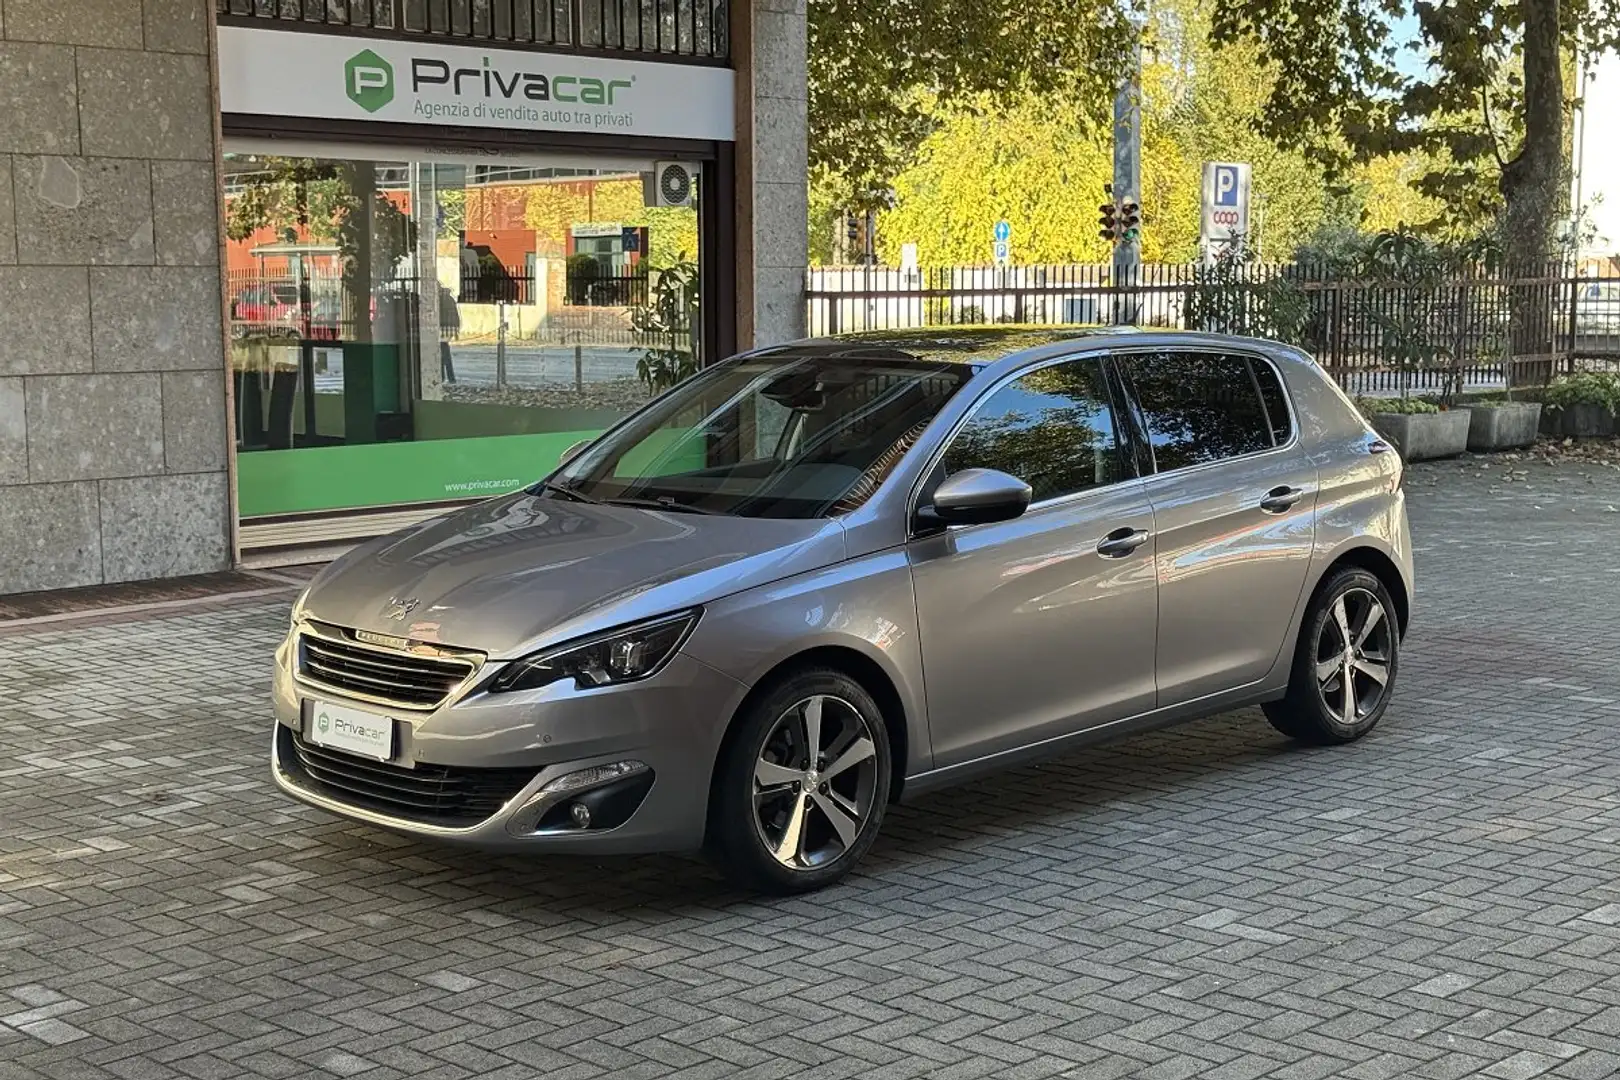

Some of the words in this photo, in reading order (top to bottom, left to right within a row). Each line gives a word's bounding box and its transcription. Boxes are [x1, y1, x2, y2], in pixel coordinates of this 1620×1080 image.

[354, 66, 388, 95] P
[411, 57, 632, 105] Privacar
[414, 99, 470, 119] Agenzia
[473, 102, 486, 118] di
[490, 104, 539, 121] vendita
[542, 110, 571, 123] auto
[574, 111, 591, 124] tra
[594, 112, 633, 128] privati
[1217, 168, 1234, 202] P
[998, 245, 1006, 257] P
[444, 478, 520, 492] www.privacar.com
[335, 718, 385, 739] Privacar
